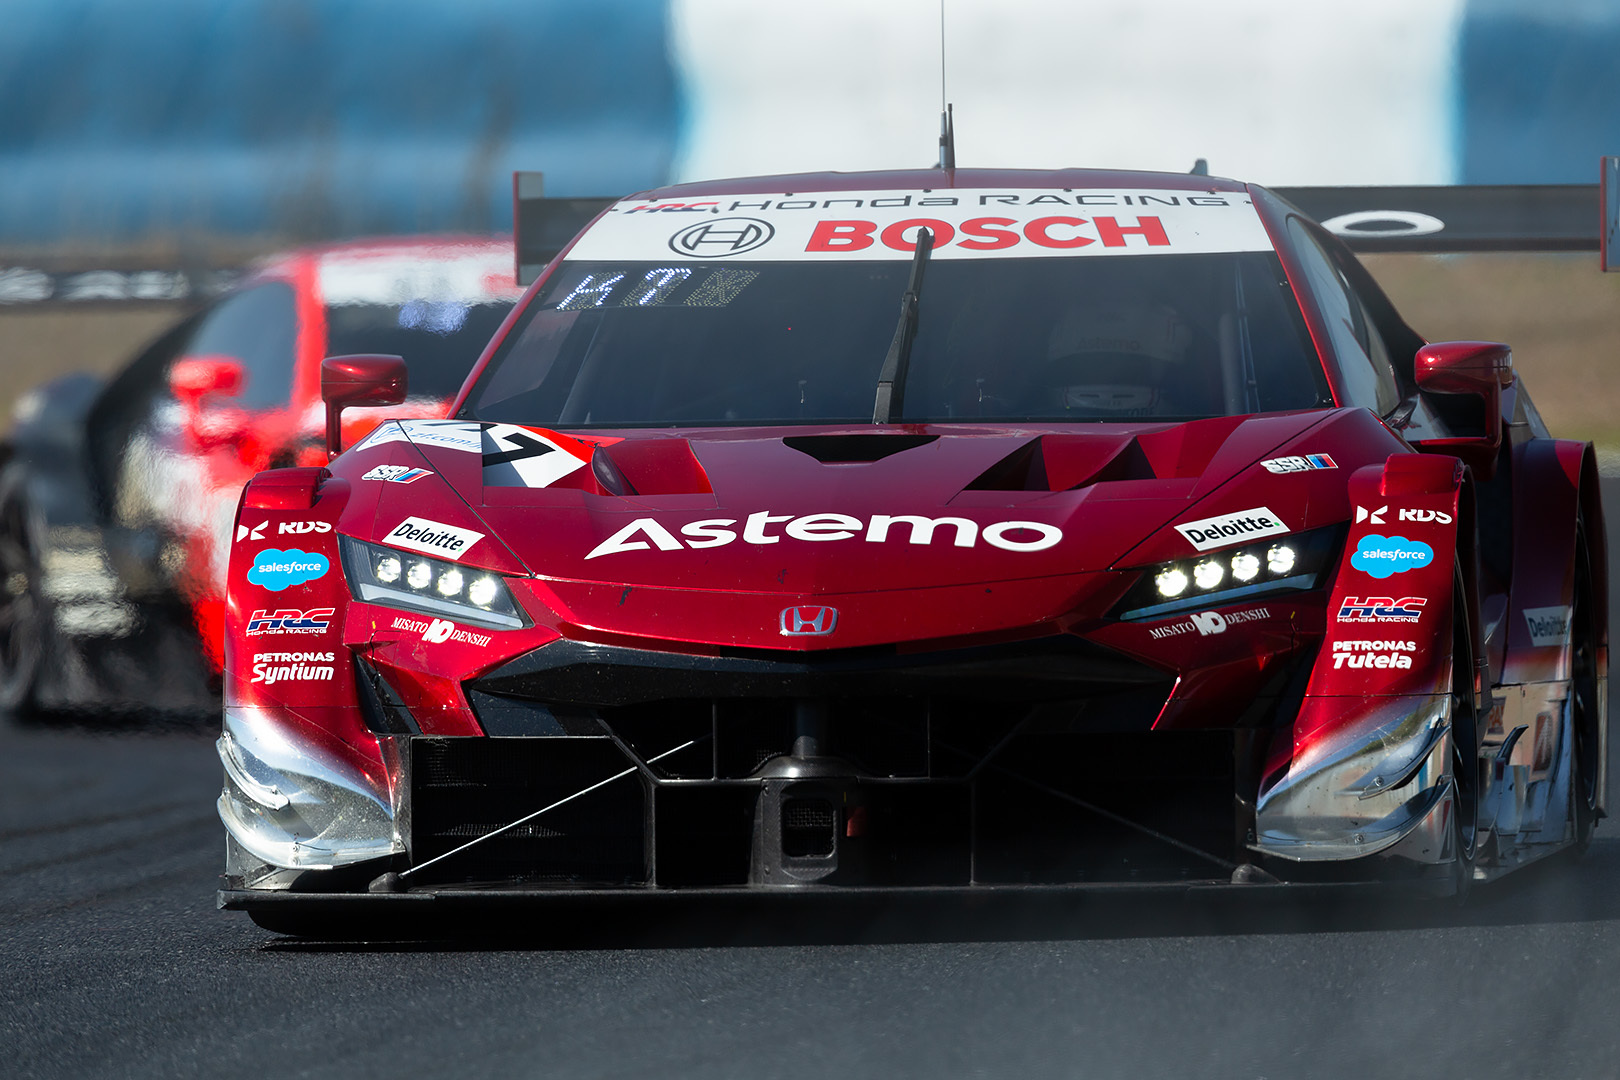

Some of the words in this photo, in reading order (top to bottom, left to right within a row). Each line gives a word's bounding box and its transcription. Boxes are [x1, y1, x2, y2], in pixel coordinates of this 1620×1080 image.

[623, 202, 720, 214] HRC
[728, 195, 959, 212] Honda
[978, 194, 1230, 207] RACING
[804, 216, 1171, 252] BOSCH
[584, 511, 1063, 560] Astemo
[1362, 549, 1426, 562] salesforce
[258, 561, 322, 575] salesforce
[1337, 596, 1428, 618] HRC
[246, 607, 336, 633] HRC
[1149, 621, 1196, 640] MISATO
[1224, 607, 1271, 625] DENSHI
[391, 617, 429, 634] MISATO
[450, 629, 492, 647] DENSHI
[1332, 640, 1417, 652] PETRONAS
[253, 652, 335, 664] PETRONAS
[1332, 652, 1413, 669] Tutela
[250, 662, 335, 685] Syntium
